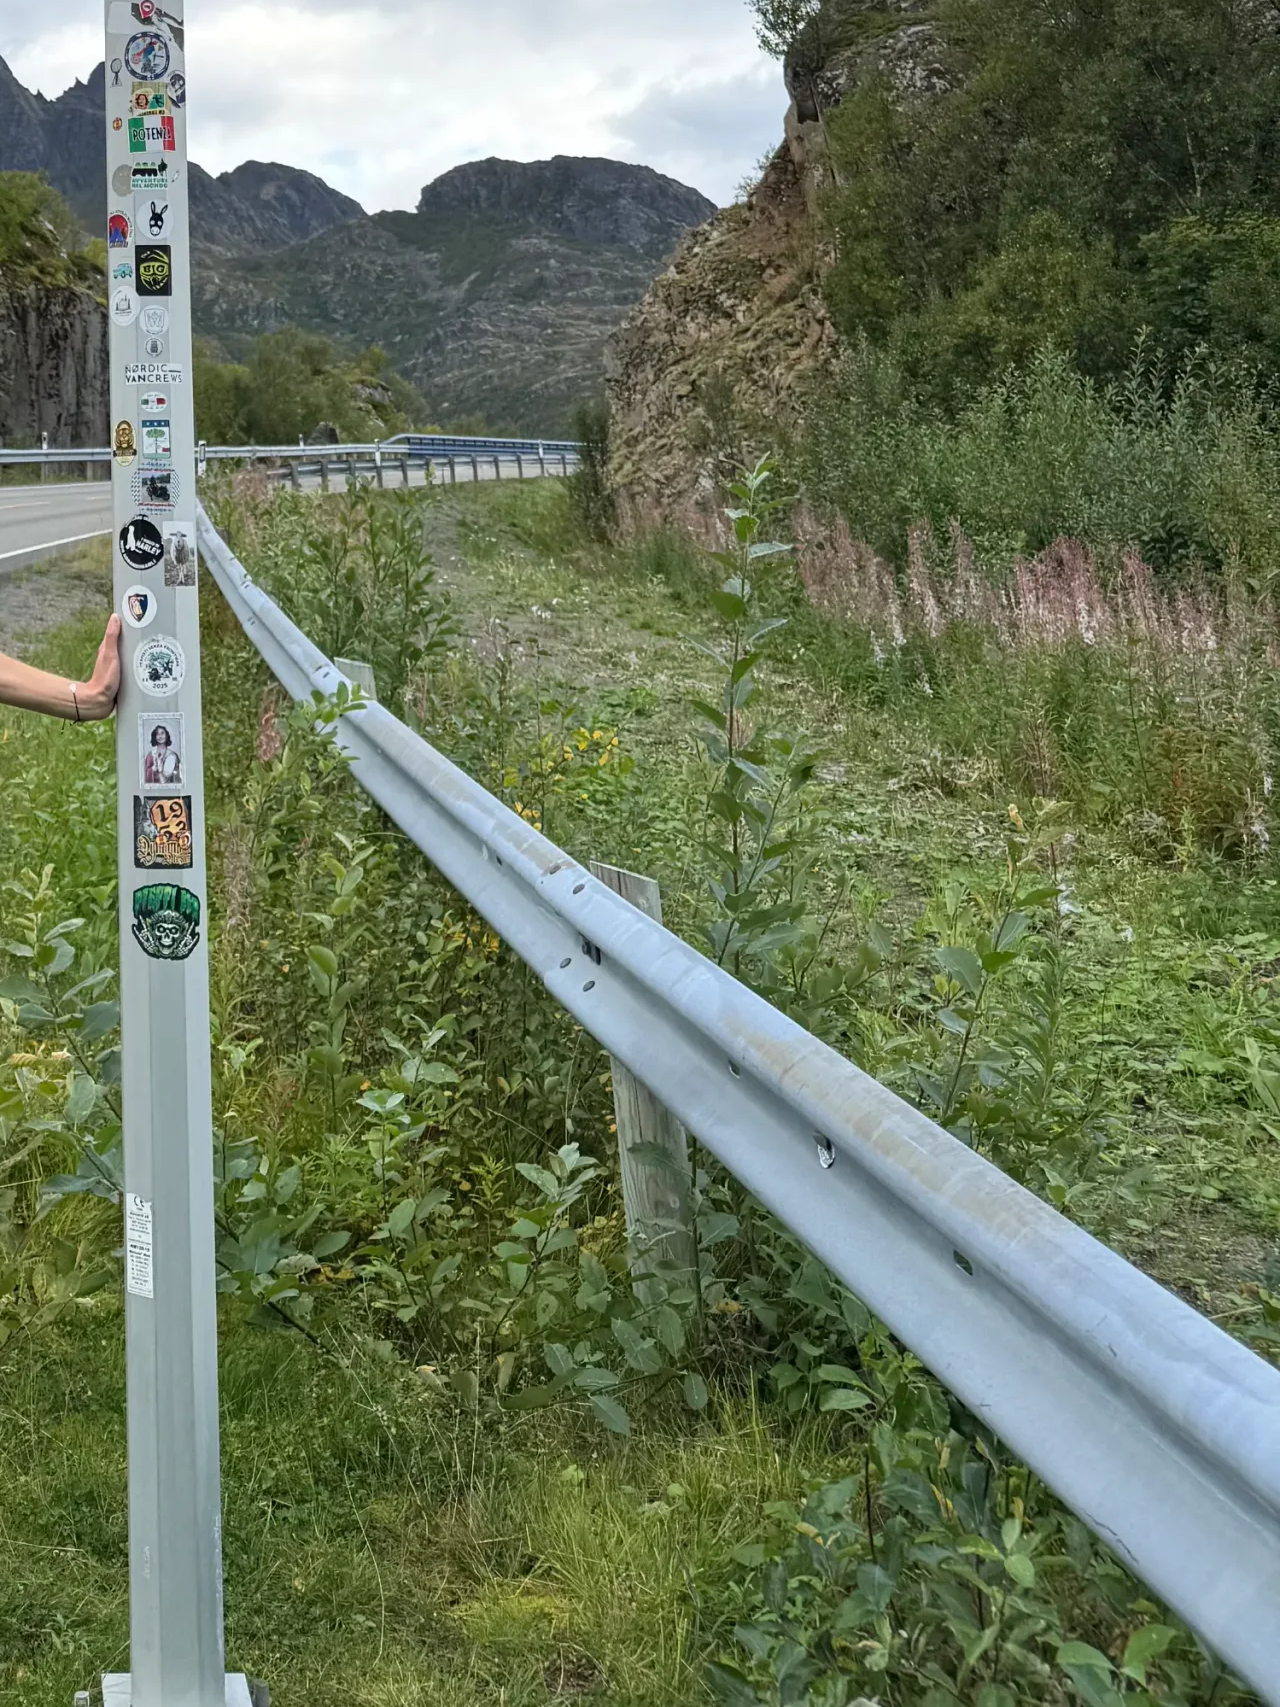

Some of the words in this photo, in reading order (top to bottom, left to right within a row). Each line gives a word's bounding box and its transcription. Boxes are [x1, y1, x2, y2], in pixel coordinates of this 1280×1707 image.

[143, 264, 165, 274] BIG
[125, 374, 182, 383] VANCREWS
[135, 540, 162, 556] HARLEY
[156, 801, 183, 823] 19
